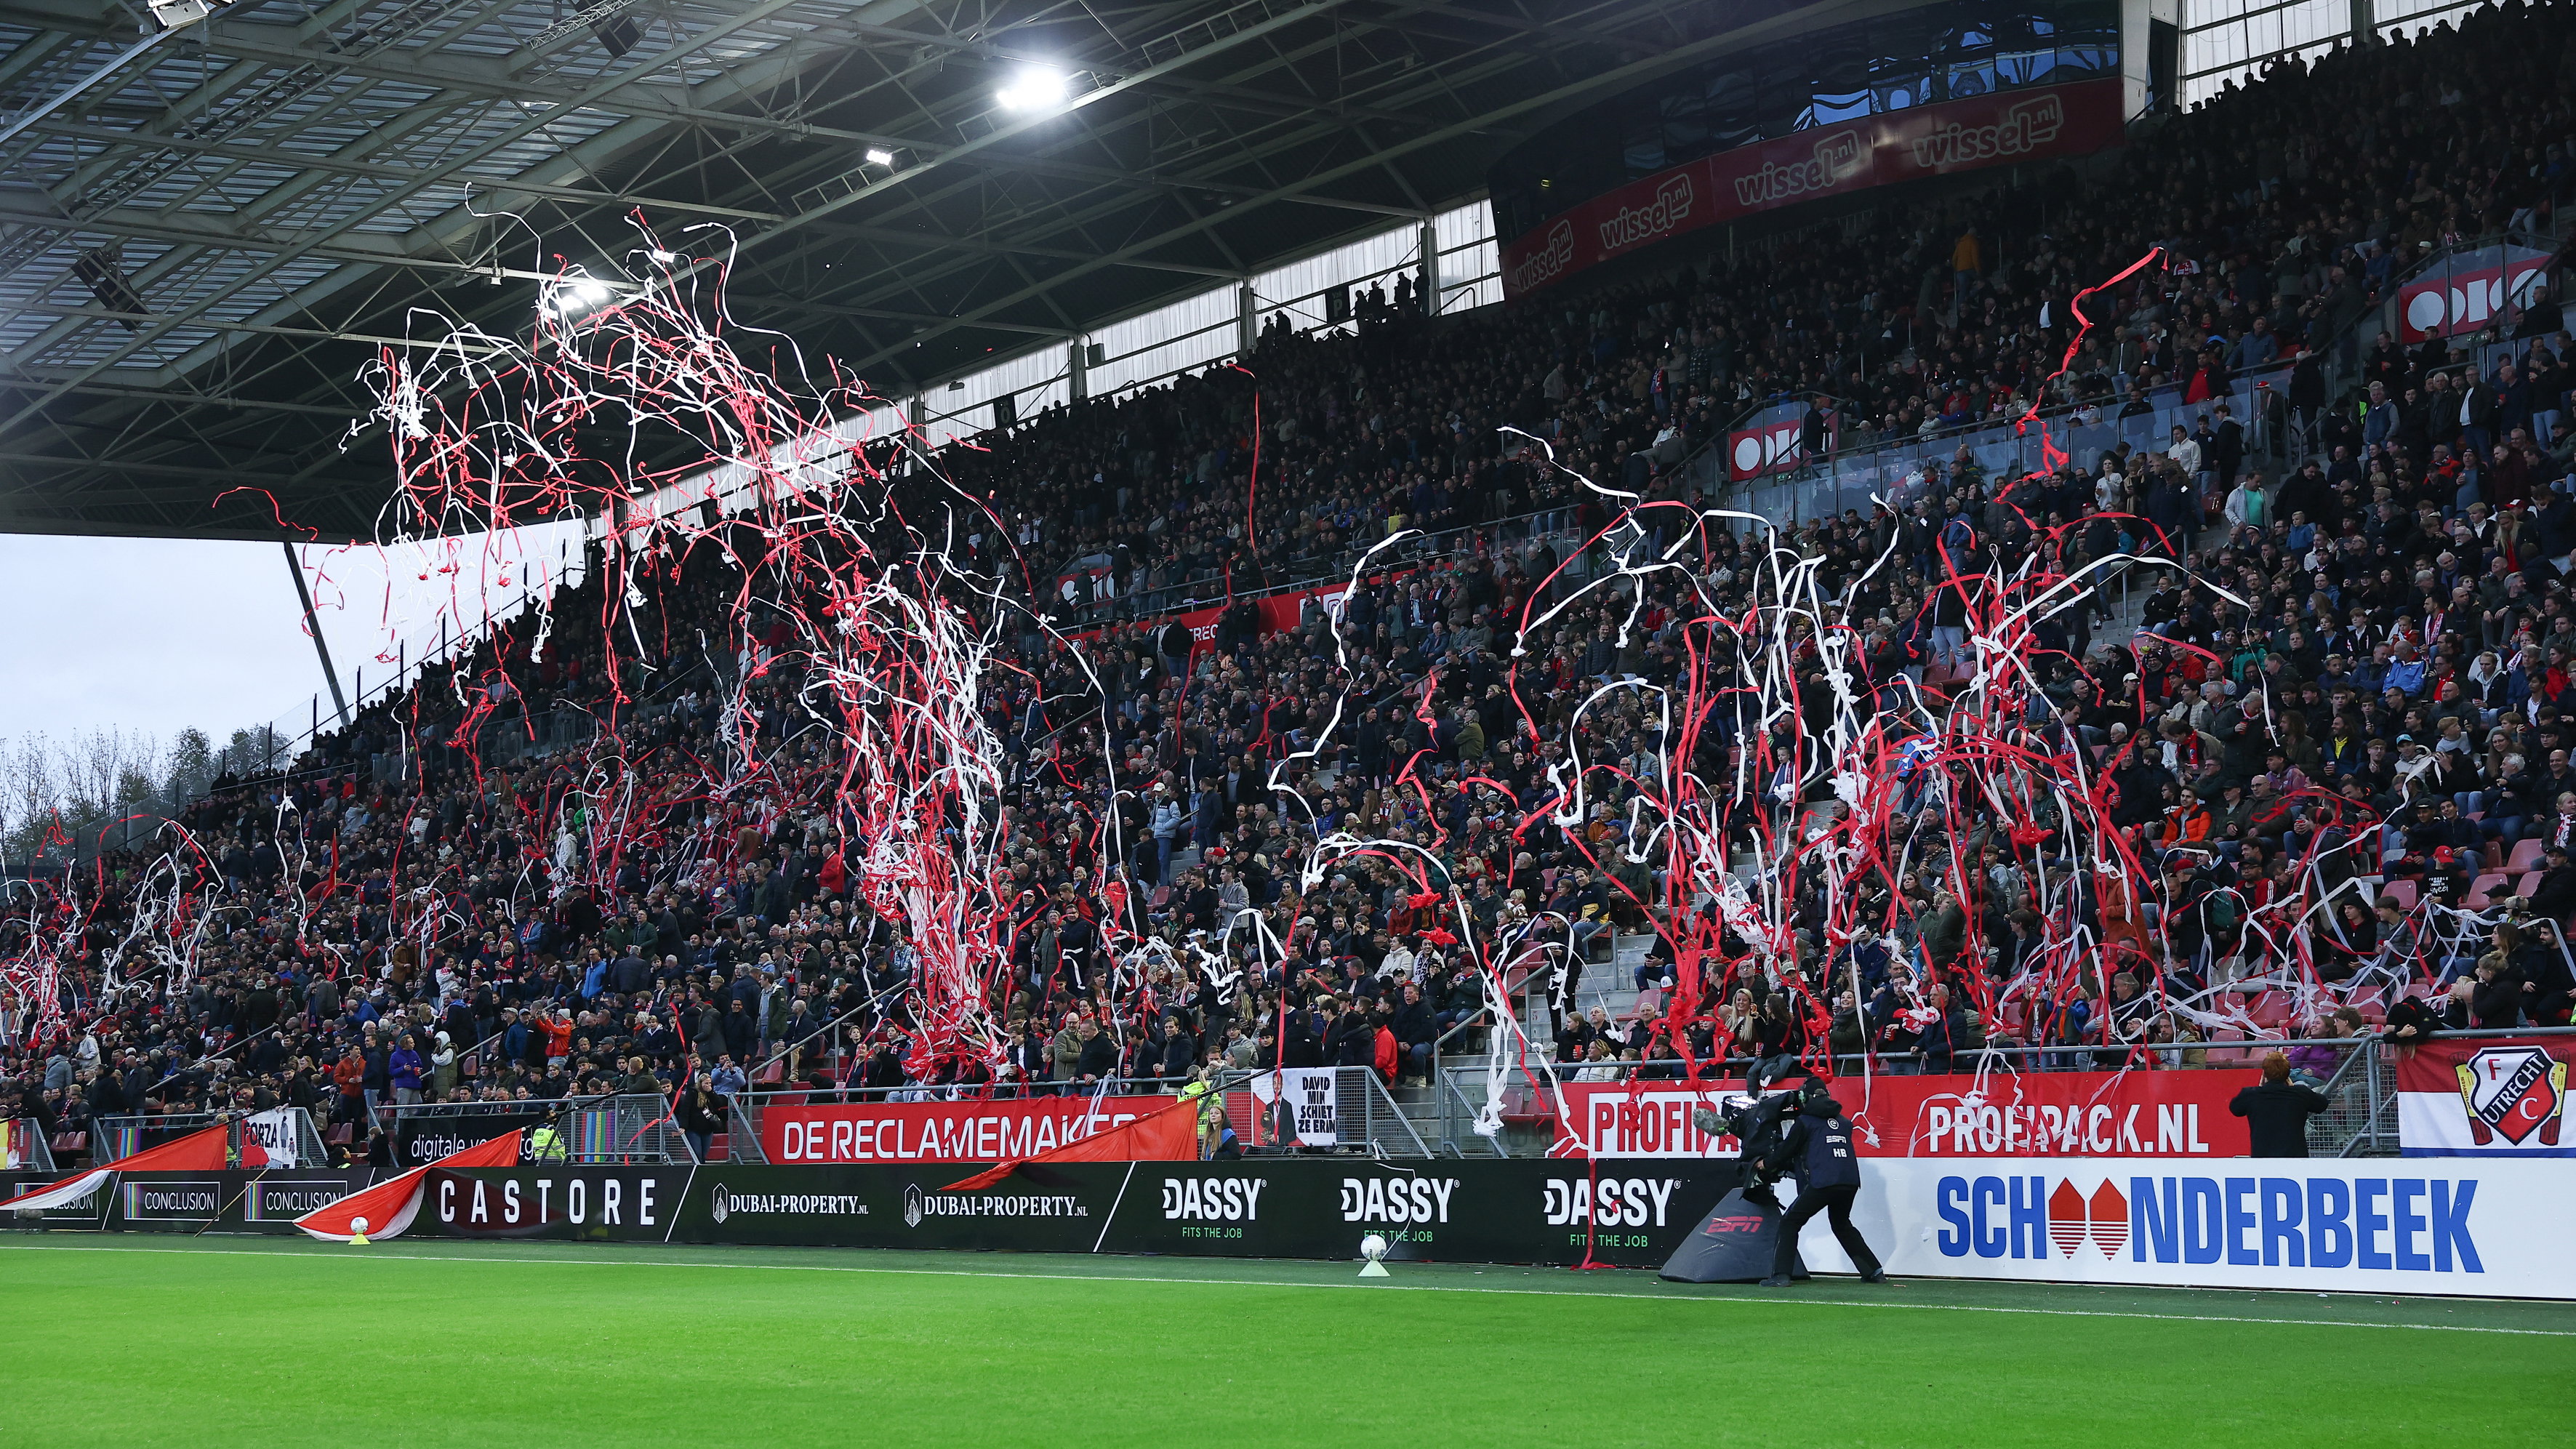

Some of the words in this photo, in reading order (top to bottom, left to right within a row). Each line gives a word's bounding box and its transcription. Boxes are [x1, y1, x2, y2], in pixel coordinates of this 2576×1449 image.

[1911, 104, 2056, 167] wissel.nl
[1735, 138, 1854, 206] wissel.nl
[1600, 182, 1688, 249] wissel.nl
[1333, 299, 1343, 318] P
[2488, 1059, 2502, 1081] F
[1303, 1077, 1331, 1091] DAVID
[2484, 1054, 2545, 1124] UTRECHT
[1308, 1091, 1325, 1104] MIN
[1301, 1105, 1333, 1119] SCHIET
[2519, 1097, 2539, 1120] C
[244, 1122, 278, 1149] FORZA
[1298, 1120, 1311, 1133] ZE
[1313, 1120, 1336, 1133] ERIN
[1928, 1103, 2210, 1153] PROFIPACK.NL
[784, 1120, 824, 1160] DE
[832, 1114, 1149, 1158] RECLAMEMAKE
[1826, 1135, 1847, 1144] ESPN
[412, 1133, 465, 1162] digitale
[1833, 1148, 1847, 1157] HB
[145, 1192, 214, 1211] CONCLUSION
[441, 1179, 655, 1226] CASTORE
[729, 1195, 869, 1214] DUBAI-PROPERTY.NL
[924, 1196, 1088, 1216] DUBAI-PROPERTY.NL
[1183, 1227, 1200, 1237] FITS
[1204, 1227, 1221, 1238] THE
[1224, 1227, 1243, 1238] JOB
[1706, 1216, 1764, 1234] ESPN
[1389, 1230, 1408, 1241] THE
[1413, 1231, 1433, 1242] JOB
[1570, 1234, 1594, 1246] FIT
[1599, 1235, 1621, 1247] THE
[1625, 1235, 1648, 1247] JOB
